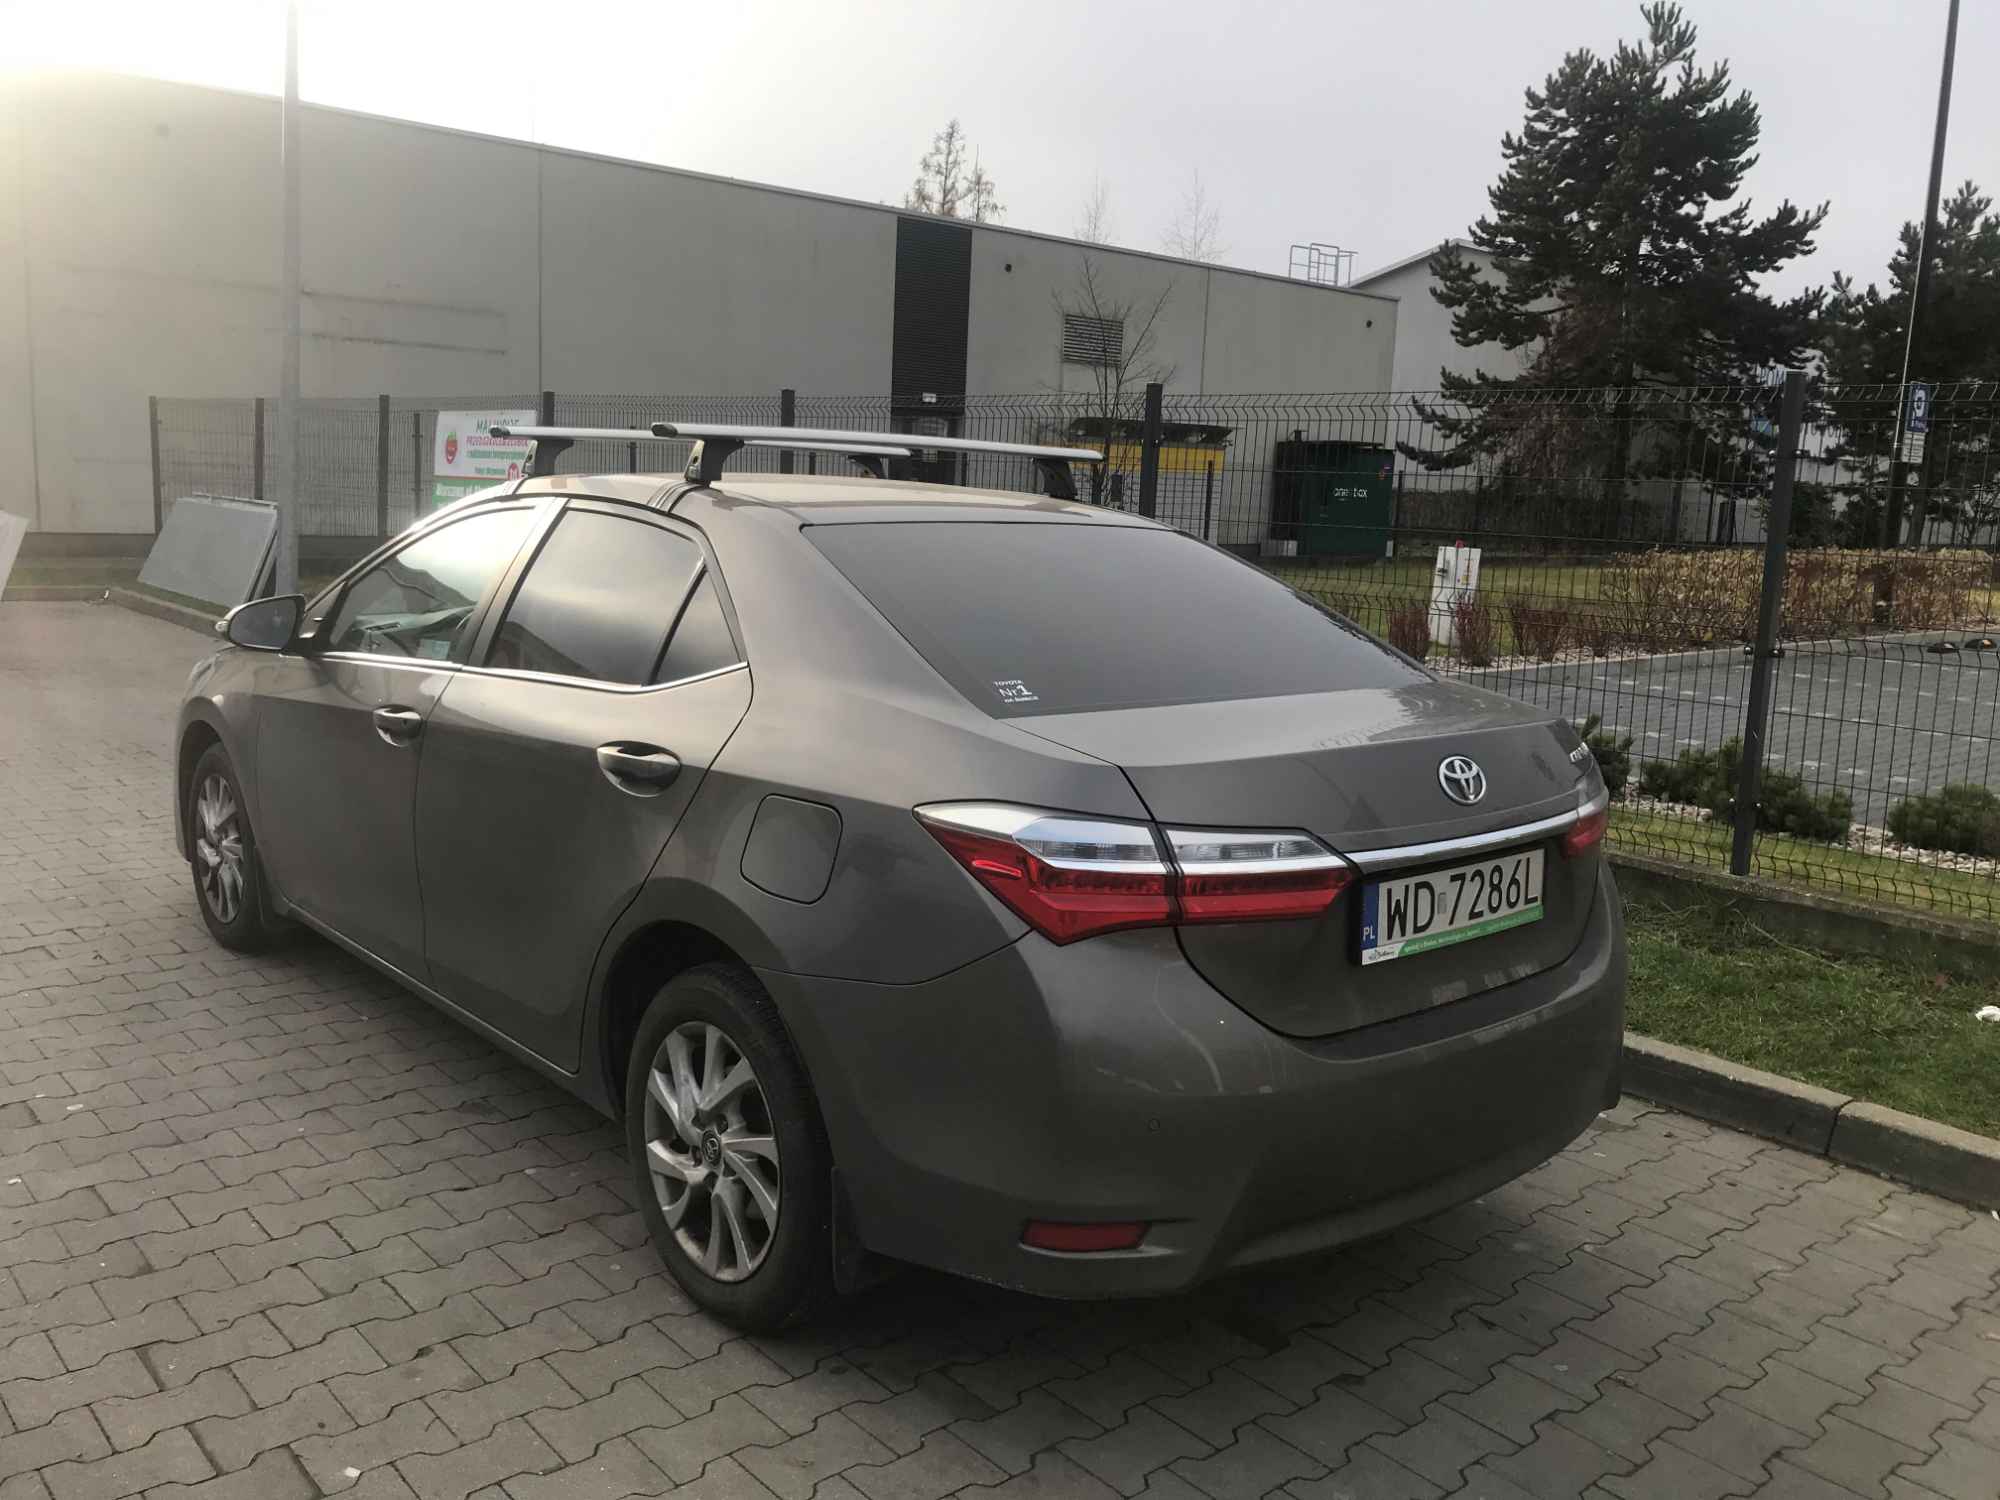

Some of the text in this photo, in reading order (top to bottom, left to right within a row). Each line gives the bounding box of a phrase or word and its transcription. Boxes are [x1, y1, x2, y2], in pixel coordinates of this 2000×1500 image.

[1386, 880, 1436, 941] WD
[1448, 856, 1539, 926] 7286L
[1362, 925, 1376, 942] PL
